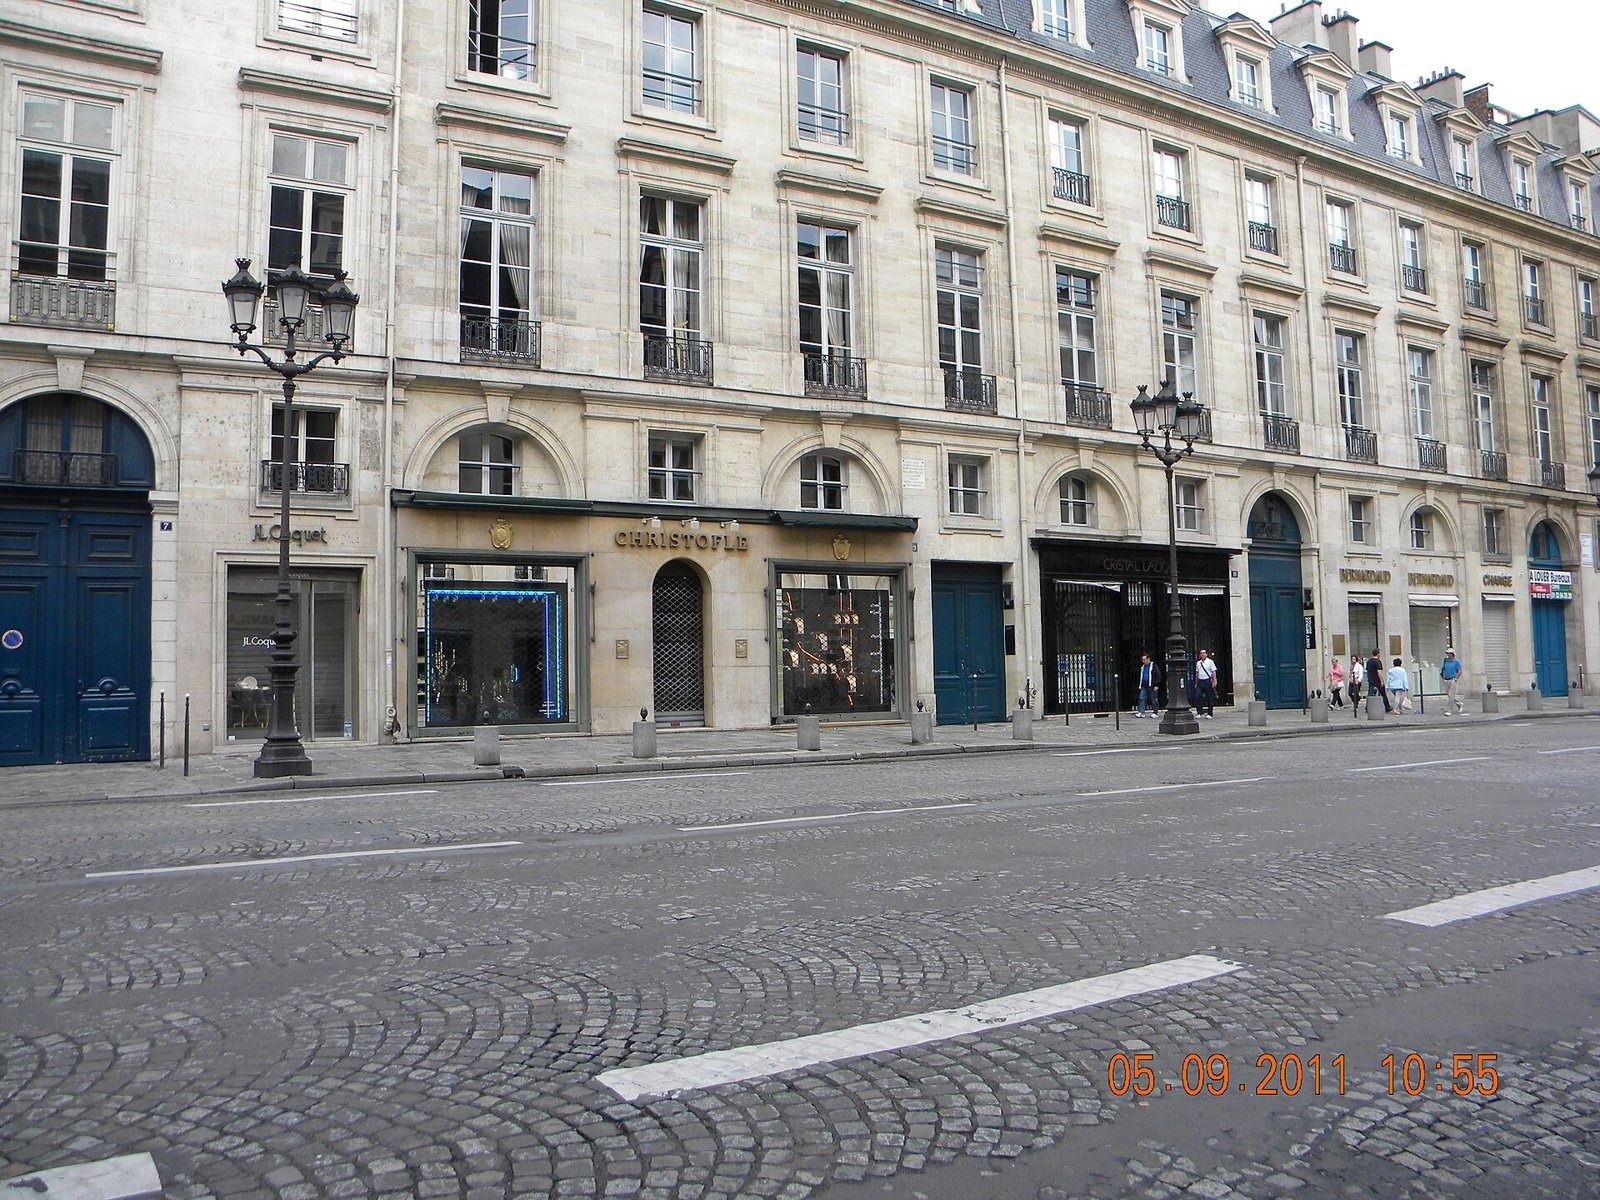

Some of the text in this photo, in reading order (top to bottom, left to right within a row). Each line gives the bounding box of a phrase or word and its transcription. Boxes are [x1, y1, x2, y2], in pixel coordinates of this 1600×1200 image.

[615, 531, 749, 551] CHRISTOFLE
[1103, 558, 1180, 575] CRISTAL LALIQE
[1339, 568, 1391, 584] BERNARDAUD
[1408, 572, 1454, 588] BERNARDAUD
[1483, 574, 1513, 588] CHANGE
[1534, 571, 1550, 582] LOUER
